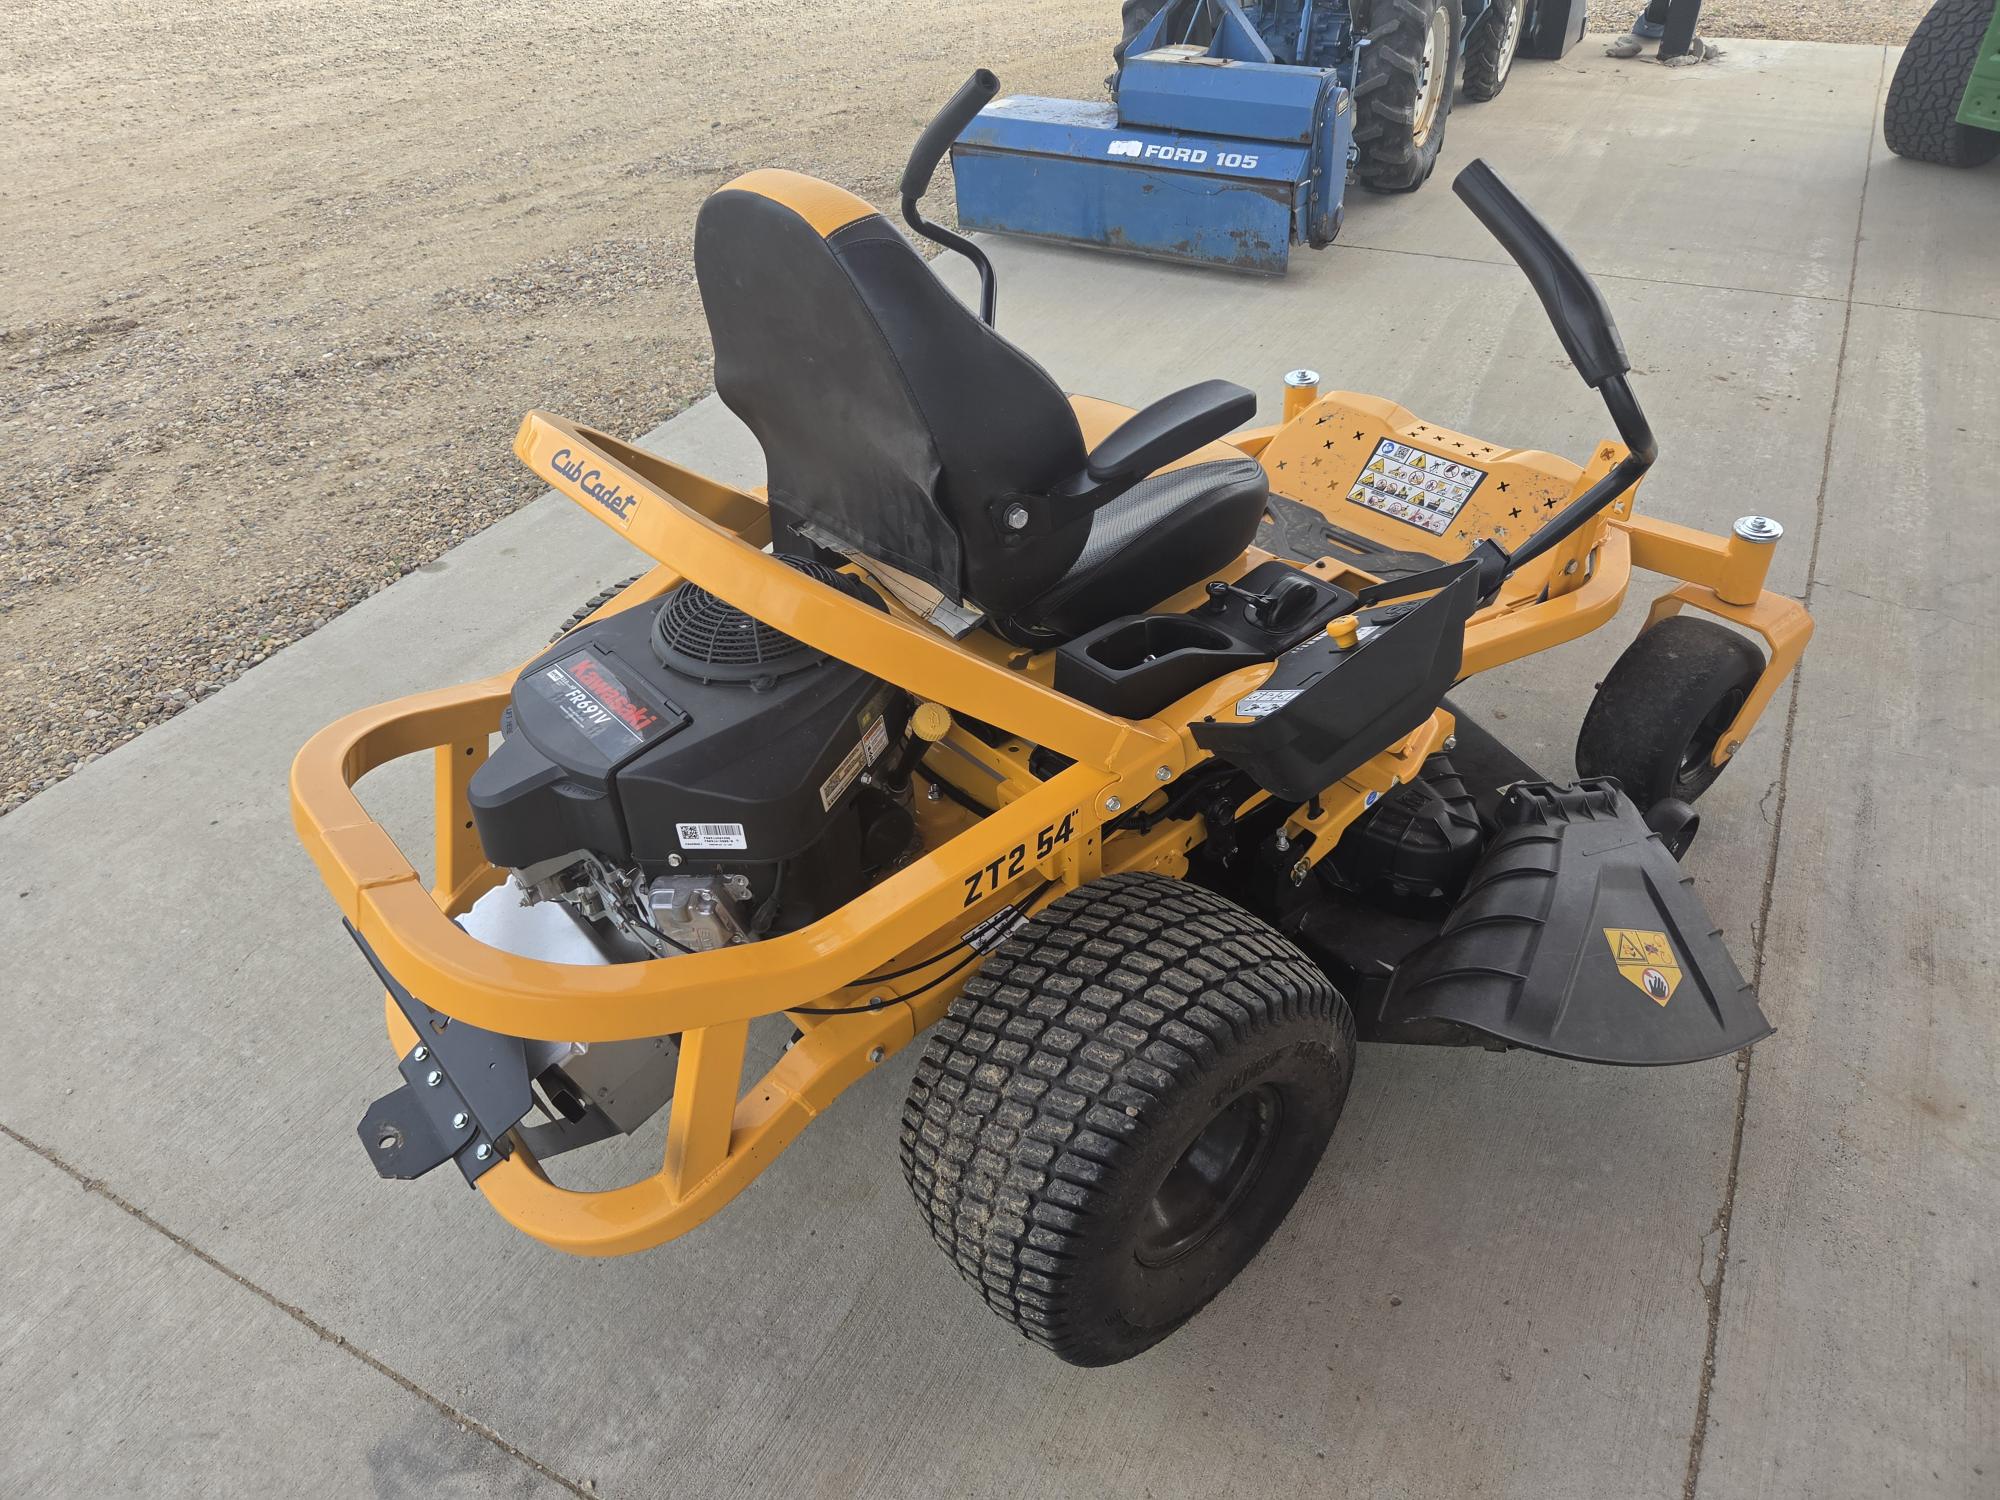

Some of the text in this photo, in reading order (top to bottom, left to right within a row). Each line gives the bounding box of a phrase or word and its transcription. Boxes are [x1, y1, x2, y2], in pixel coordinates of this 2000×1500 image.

[1145, 144, 1259, 169] FORD 105
[551, 448, 637, 521] Cub Cadet
[565, 689, 612, 724] FR691V
[568, 658, 657, 732] Kawasaki
[963, 808, 1079, 908] ZT2 54"
